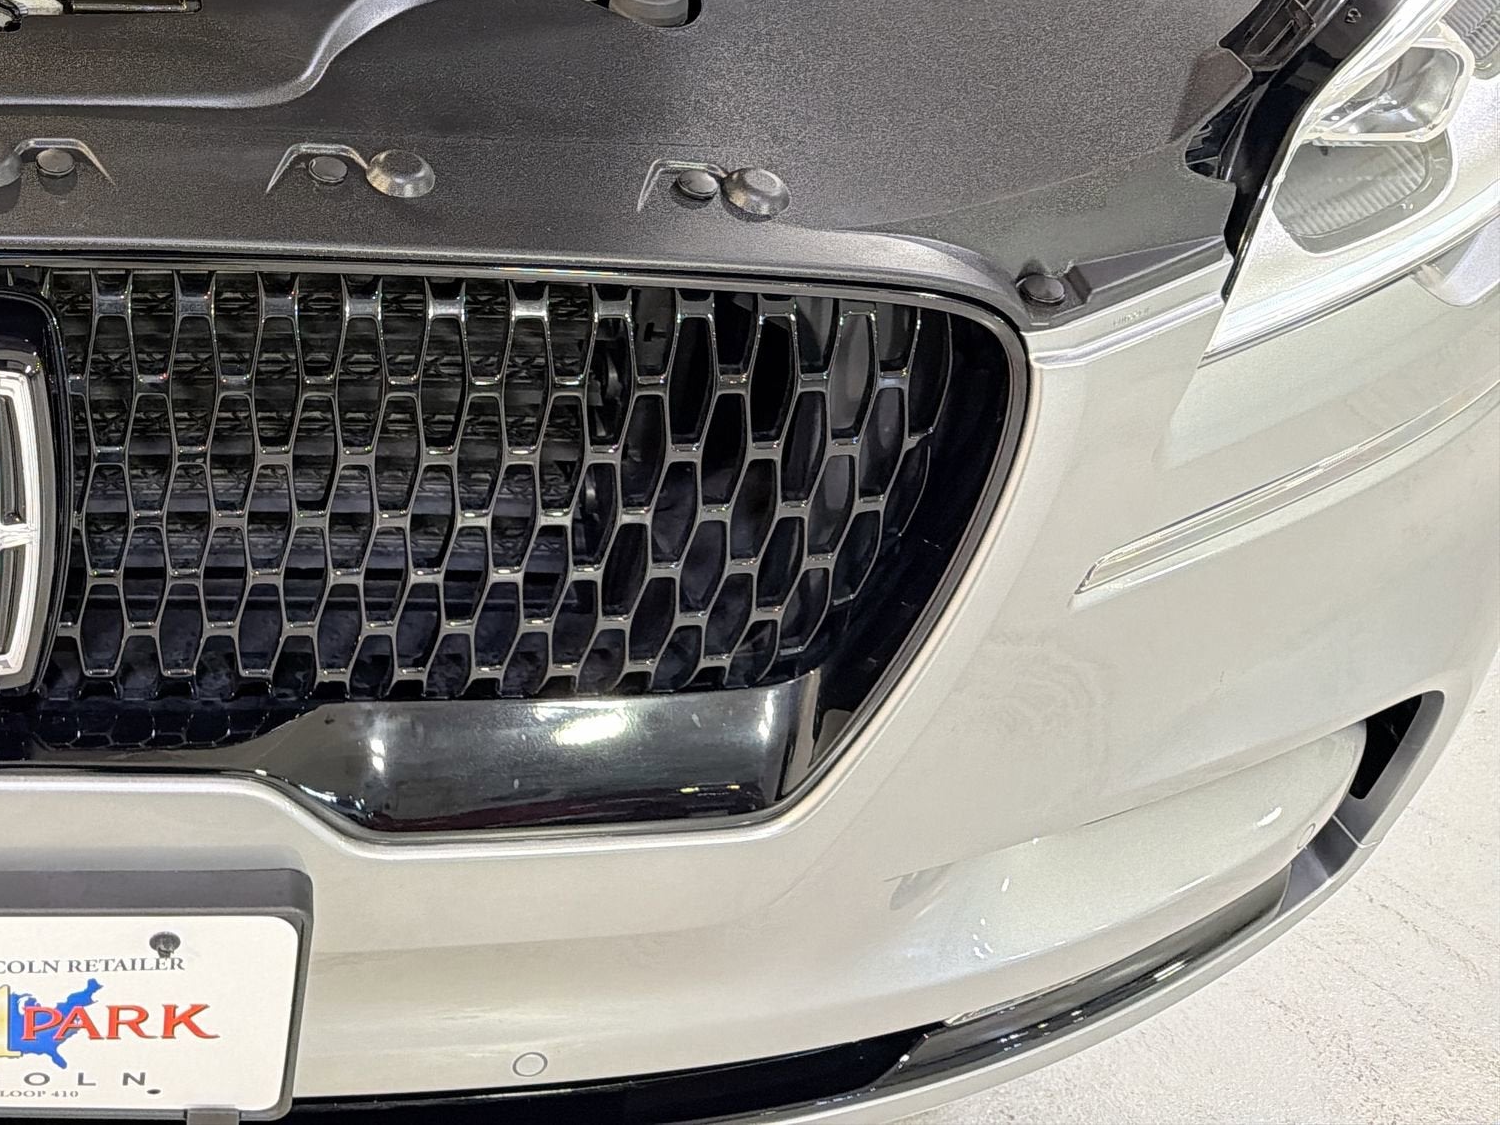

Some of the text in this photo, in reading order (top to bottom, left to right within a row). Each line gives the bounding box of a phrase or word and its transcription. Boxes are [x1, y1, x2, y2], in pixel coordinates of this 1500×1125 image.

[67, 957, 185, 973] RETAILER
[22, 1004, 220, 1041] PARK
[0, 1090, 46, 1098] LOOP
[51, 1090, 79, 1098] 410
